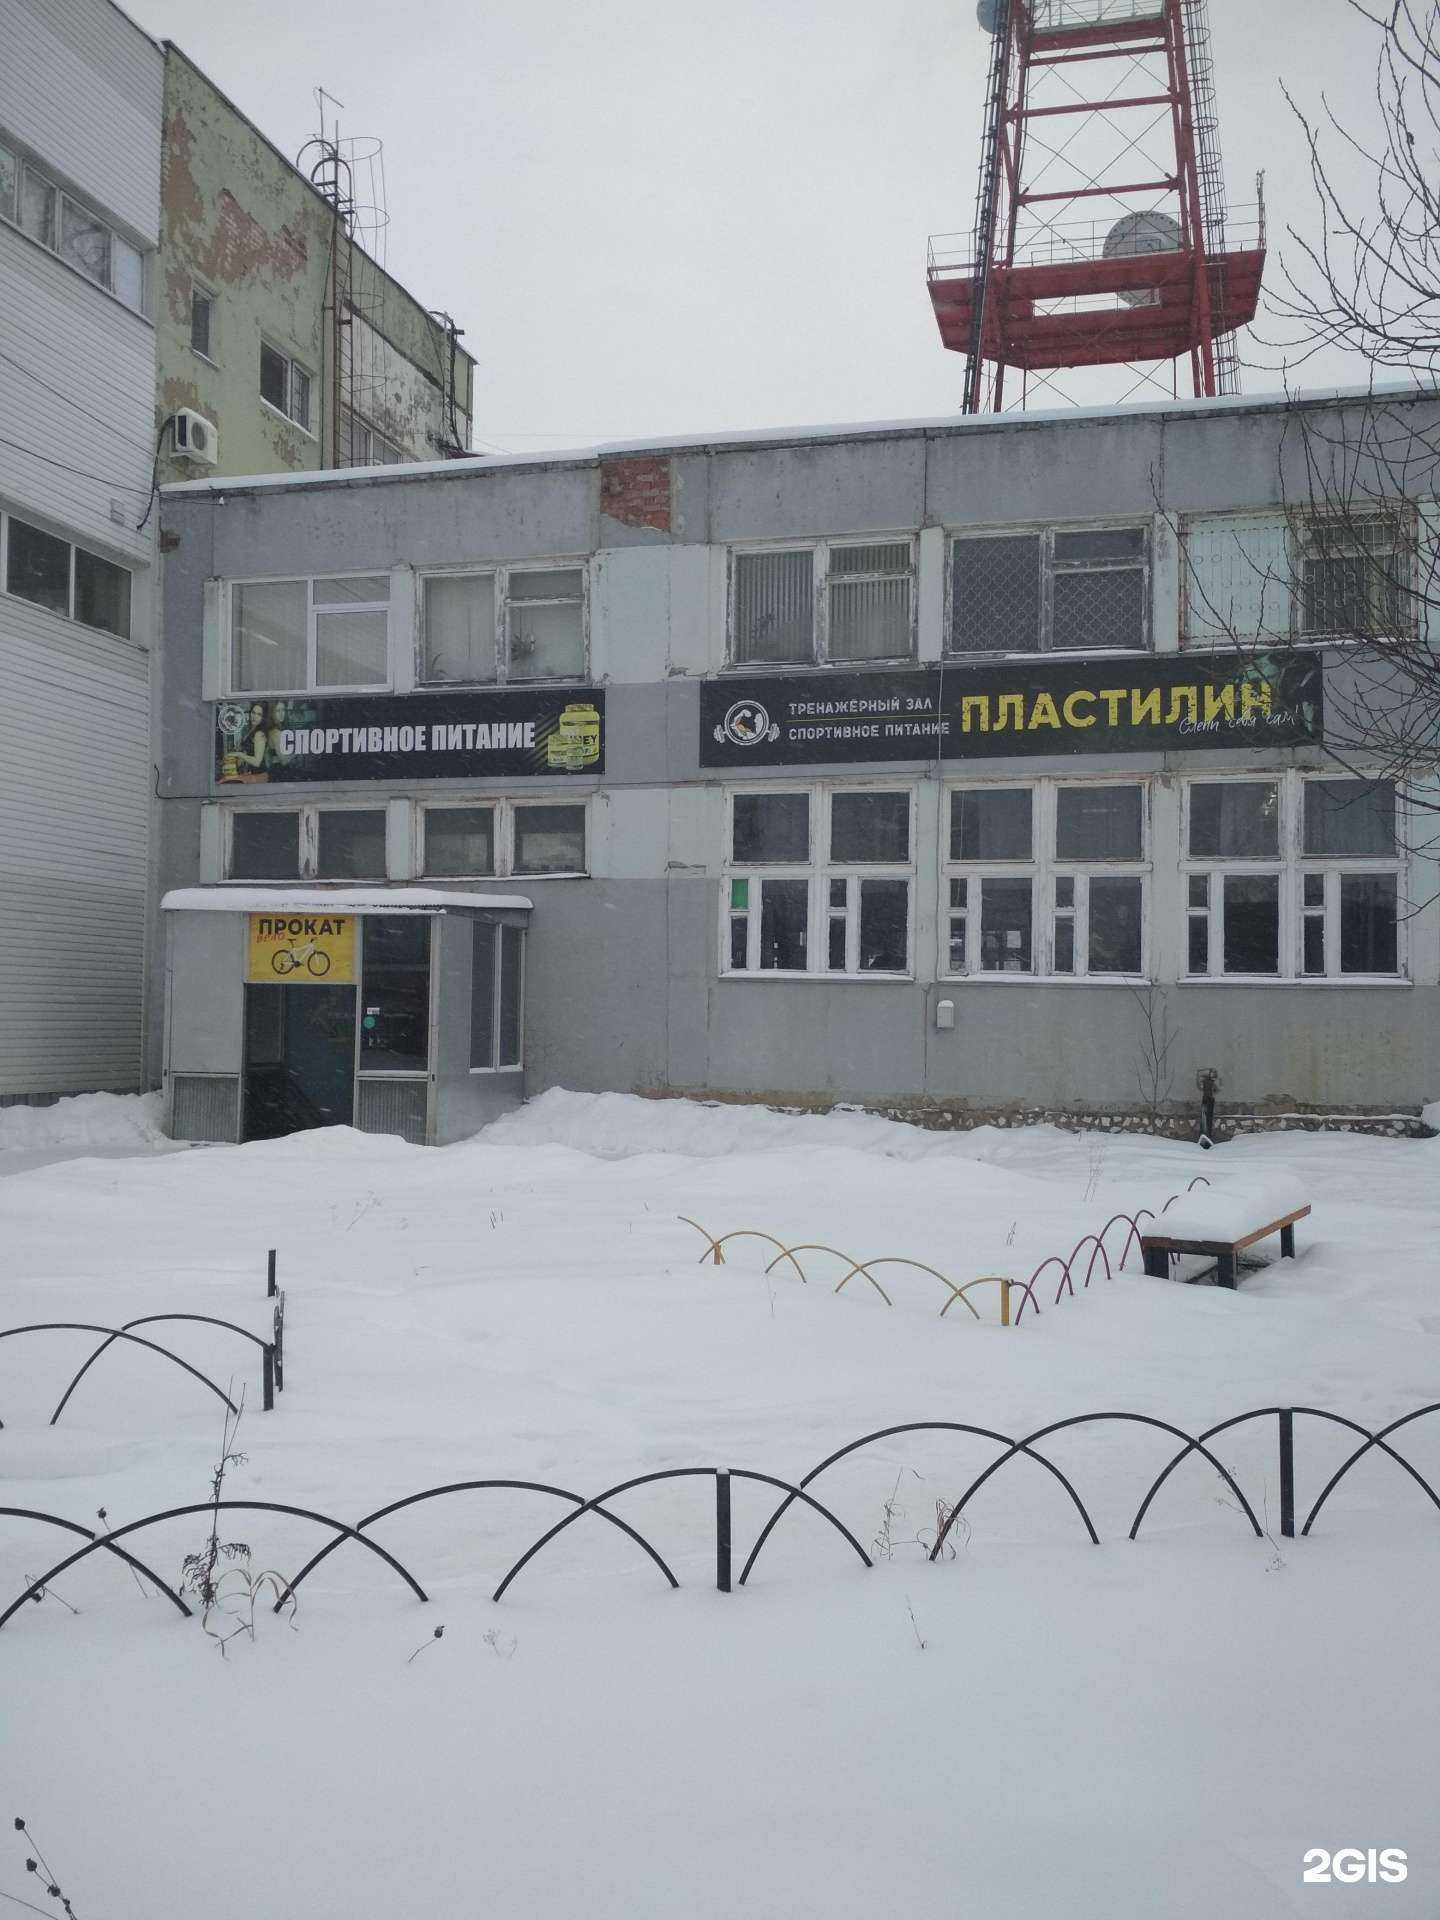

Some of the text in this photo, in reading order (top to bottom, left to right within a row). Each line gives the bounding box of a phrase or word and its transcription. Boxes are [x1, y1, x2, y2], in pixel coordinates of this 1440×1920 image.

[905, 697, 933, 711] ЗАЛ
[960, 683, 1273, 733] ПЛАСТИЛИН
[279, 721, 536, 755] СПОРТИВНОЕ ПИТАНИЕ
[788, 722, 950, 741] СПОРТИВНОЕ ПИТАНИЕ
[258, 918, 346, 936] ПРОКАТ
